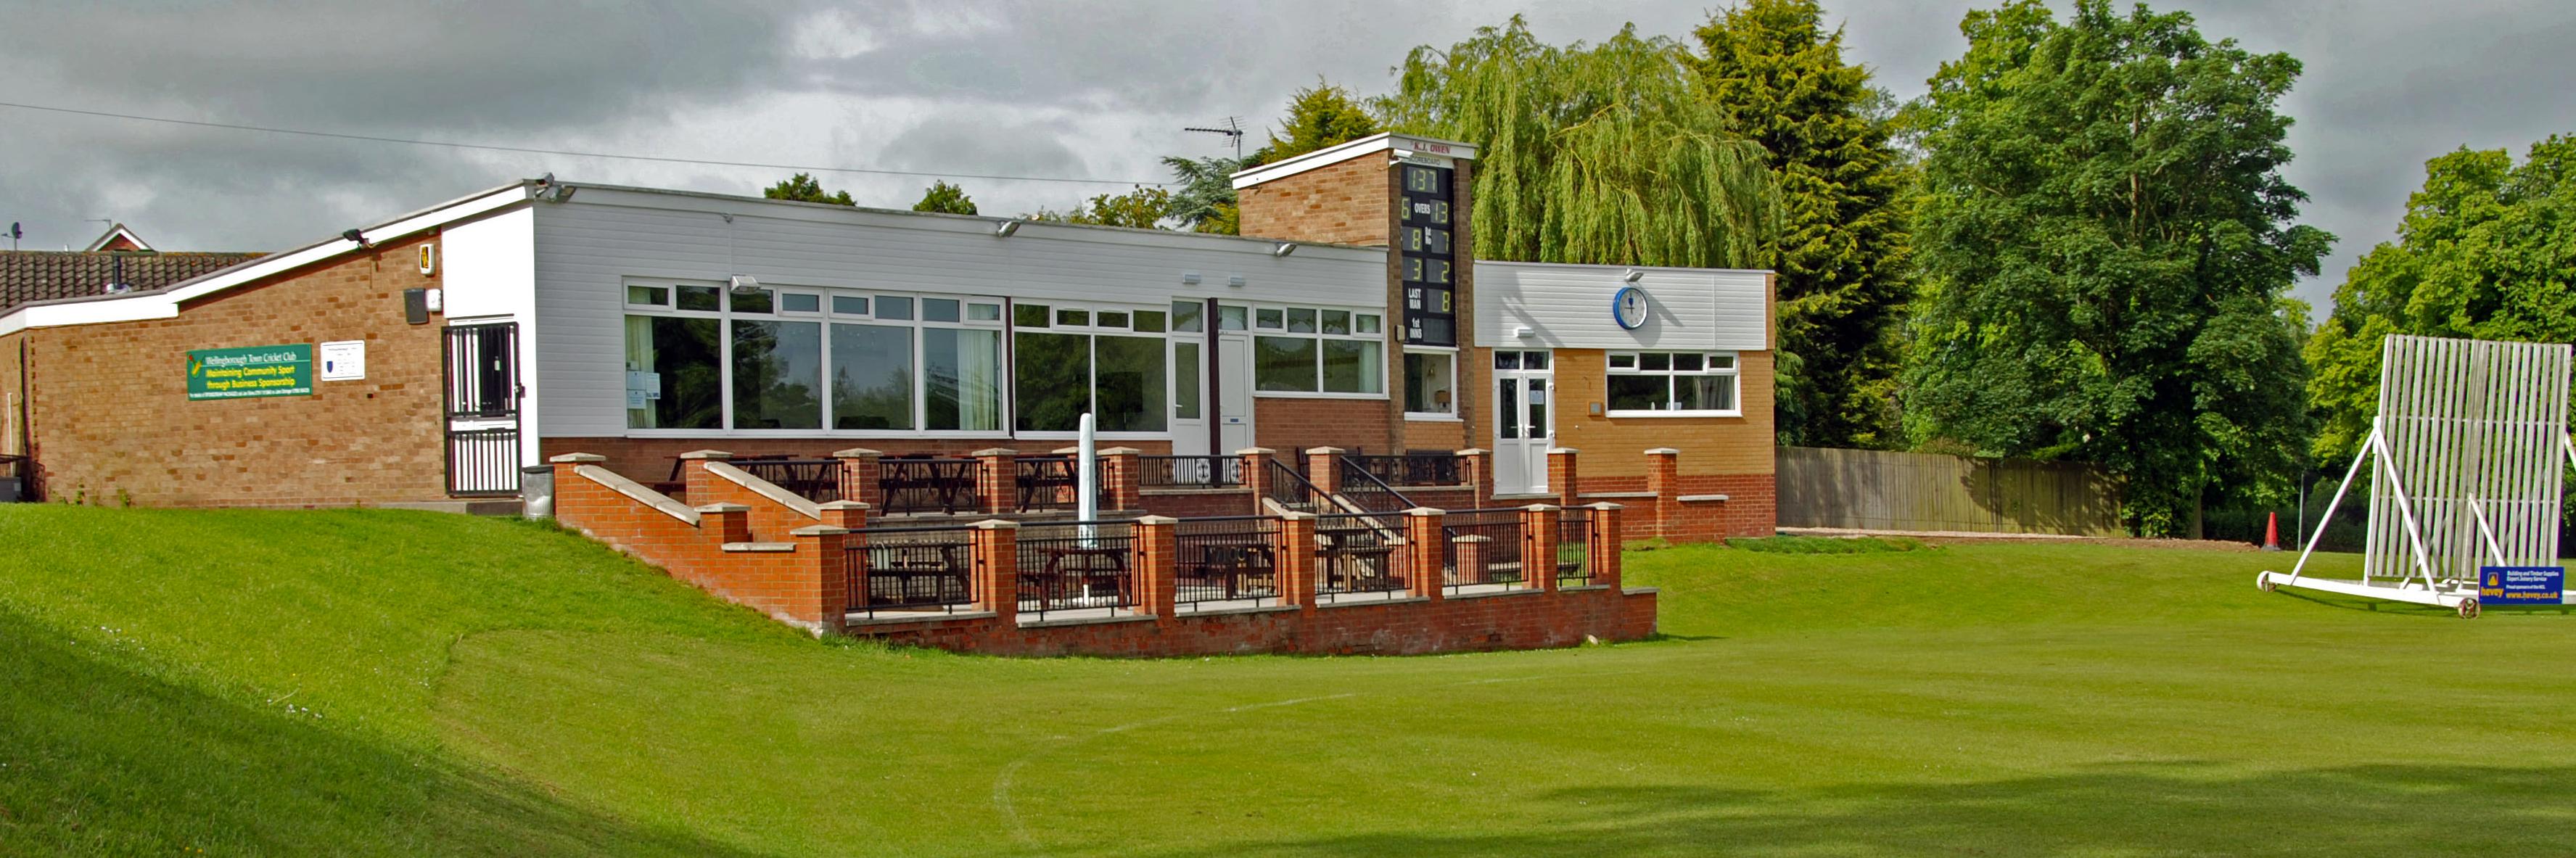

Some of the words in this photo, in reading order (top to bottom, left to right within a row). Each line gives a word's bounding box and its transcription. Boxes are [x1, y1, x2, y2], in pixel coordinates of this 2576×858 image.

[1430, 144, 1451, 154] OWEN
[1412, 170, 1436, 191] 137
[1402, 197, 1410, 219] 6
[1415, 203, 1431, 215] OVERS
[1435, 203, 1448, 223] 13
[1412, 228, 1421, 250] 8
[1442, 232, 1449, 252] 7
[1413, 259, 1422, 281] 3
[1441, 261, 1449, 282] 2
[1409, 288, 1421, 298] LAST
[1441, 291, 1450, 313] 8
[1410, 298, 1421, 310] MAN
[205, 355, 247, 367] Wellingborough
[248, 354, 263, 363] Town
[263, 352, 283, 363] Cricket
[283, 352, 297, 361] Club
[206, 368, 242, 378] Maintaining
[244, 366, 277, 376] Community
[278, 366, 295, 375] Sport
[207, 380, 231, 390] through
[231, 379, 258, 388] Business
[258, 377, 295, 388] Sponsorship
